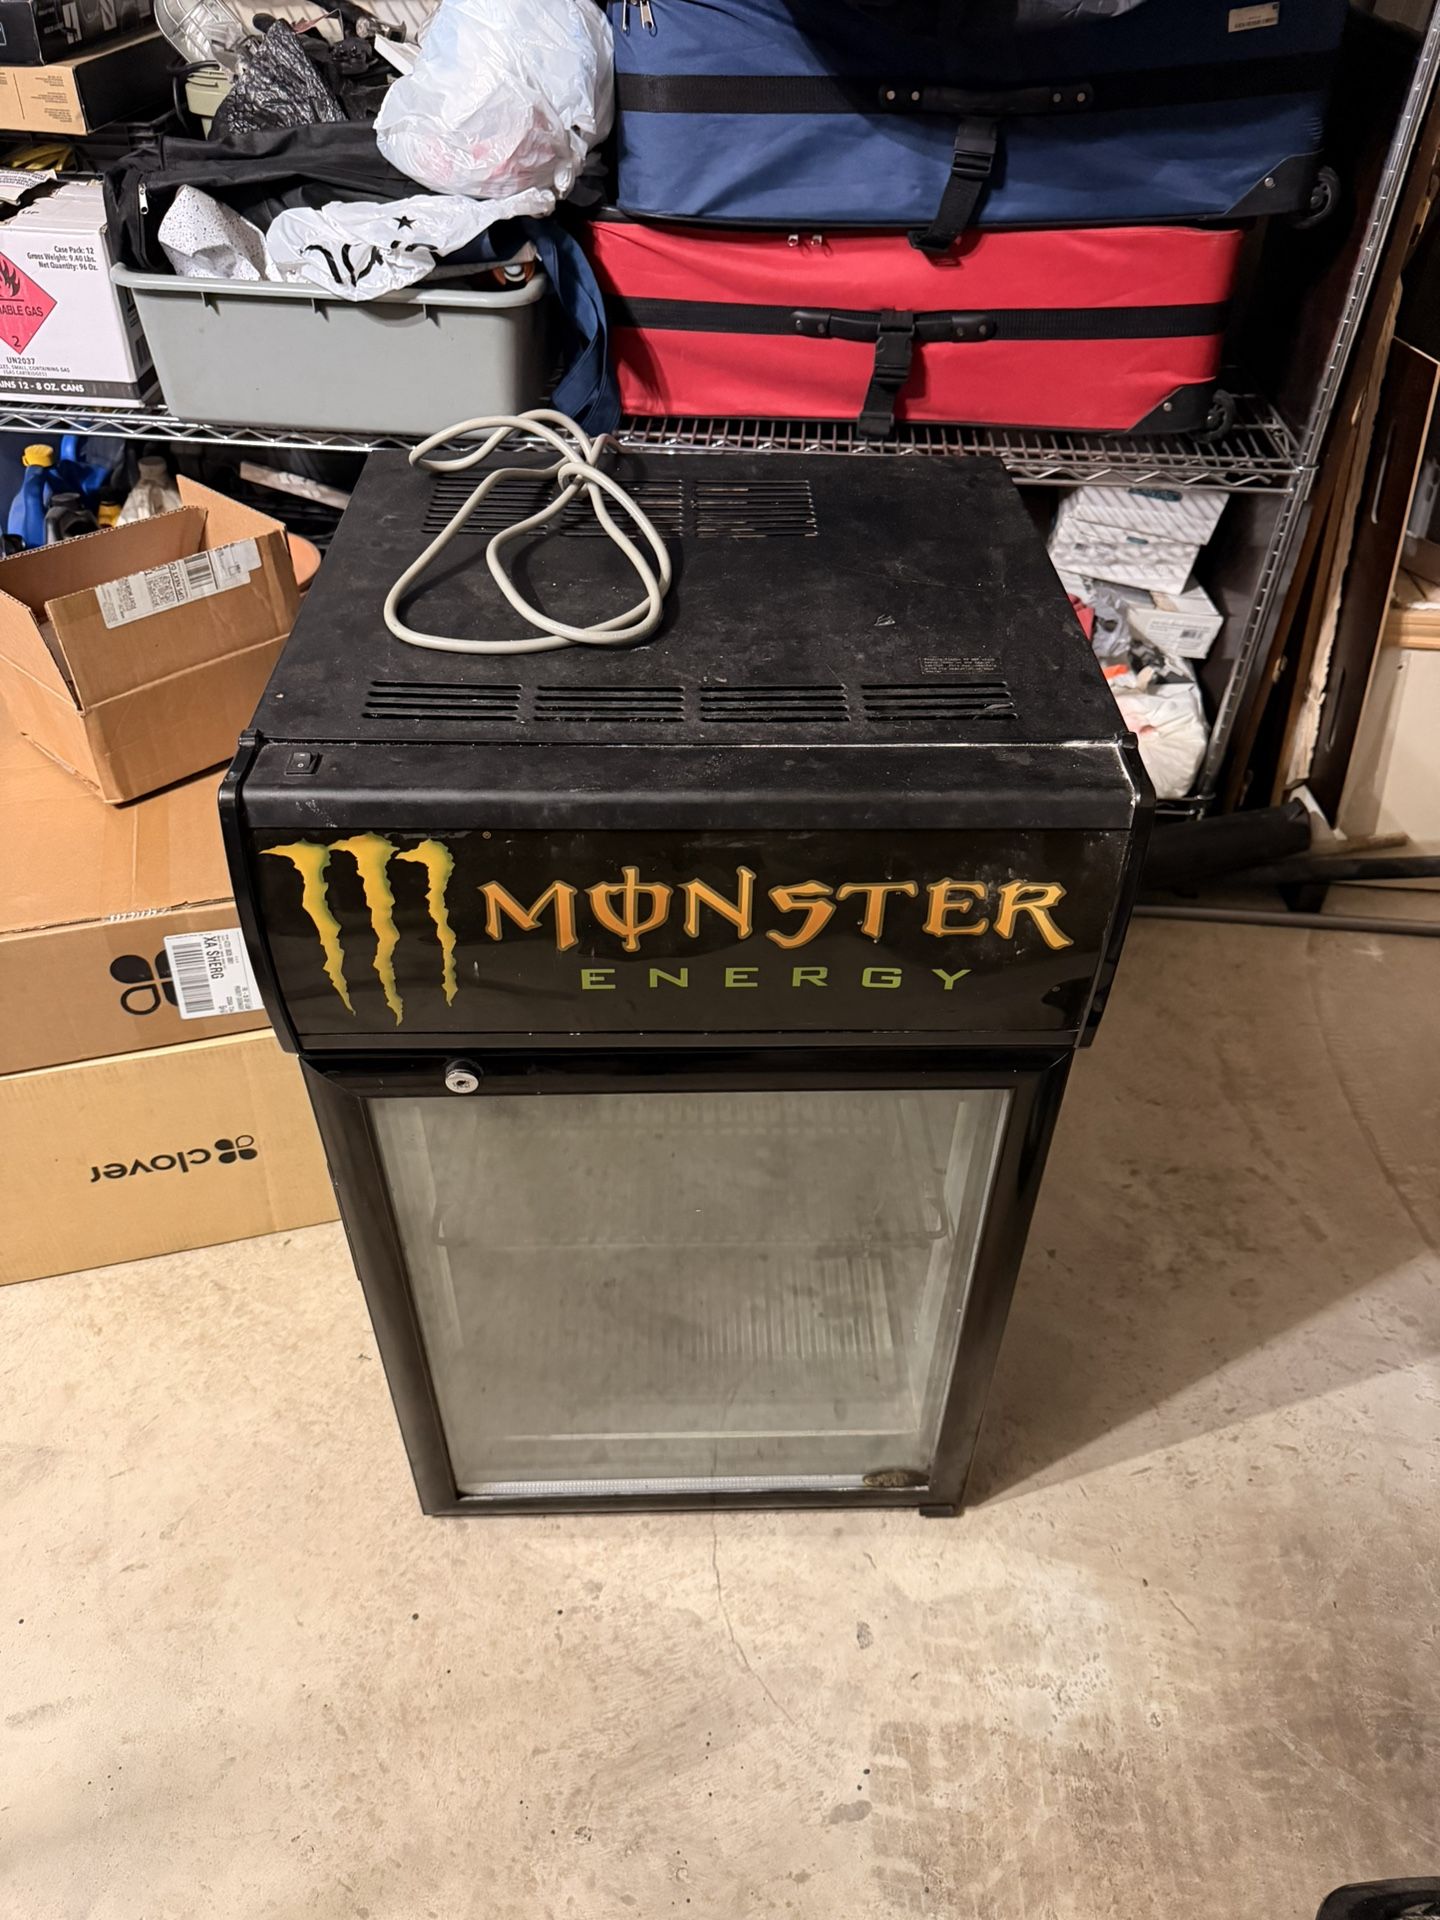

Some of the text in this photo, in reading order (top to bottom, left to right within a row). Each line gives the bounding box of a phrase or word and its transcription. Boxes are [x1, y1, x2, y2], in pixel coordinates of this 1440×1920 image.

[54, 245, 94, 255] Case Pack: 12
[27, 252, 44, 260] Gross
[44, 253, 68, 262] Weight:
[38, 261, 99, 271] Net Quantity: 96 Oz.
[0, 305, 44, 317] ABLE GAS
[11, 335, 22, 347] 2
[6, 356, 35, 365] UN2037
[17, 381, 29, 390] 12
[35, 382, 42, 391] 8
[43, 382, 60, 391] OZ.
[60, 383, 84, 393] CANS
[203, 935, 218, 949] XA
[206, 950, 225, 980] SHERG
[581, 967, 972, 991] ENERGY
[90, 1148, 212, 1183] clover
